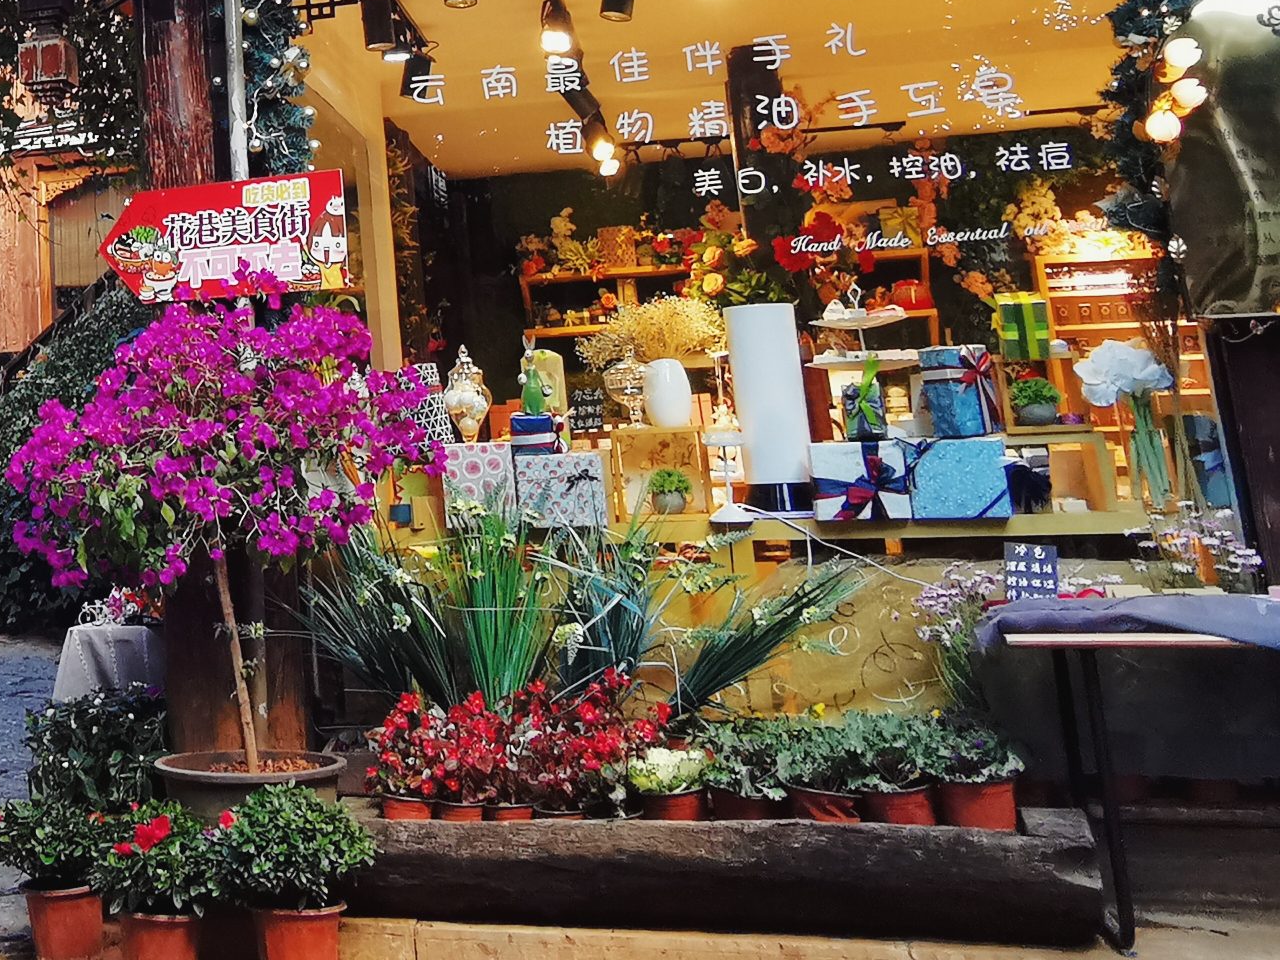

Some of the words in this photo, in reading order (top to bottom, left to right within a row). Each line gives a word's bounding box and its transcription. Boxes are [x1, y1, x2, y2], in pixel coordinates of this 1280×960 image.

[409, 22, 867, 106] 云南最佳伴手礼
[245, 180, 308, 204] 吃货必到
[164, 202, 310, 248] 花巷美食街
[790, 234, 842, 255] Hand
[855, 230, 911, 252] Made
[926, 222, 1010, 245] Essential
[180, 242, 302, 286] 不可不去
